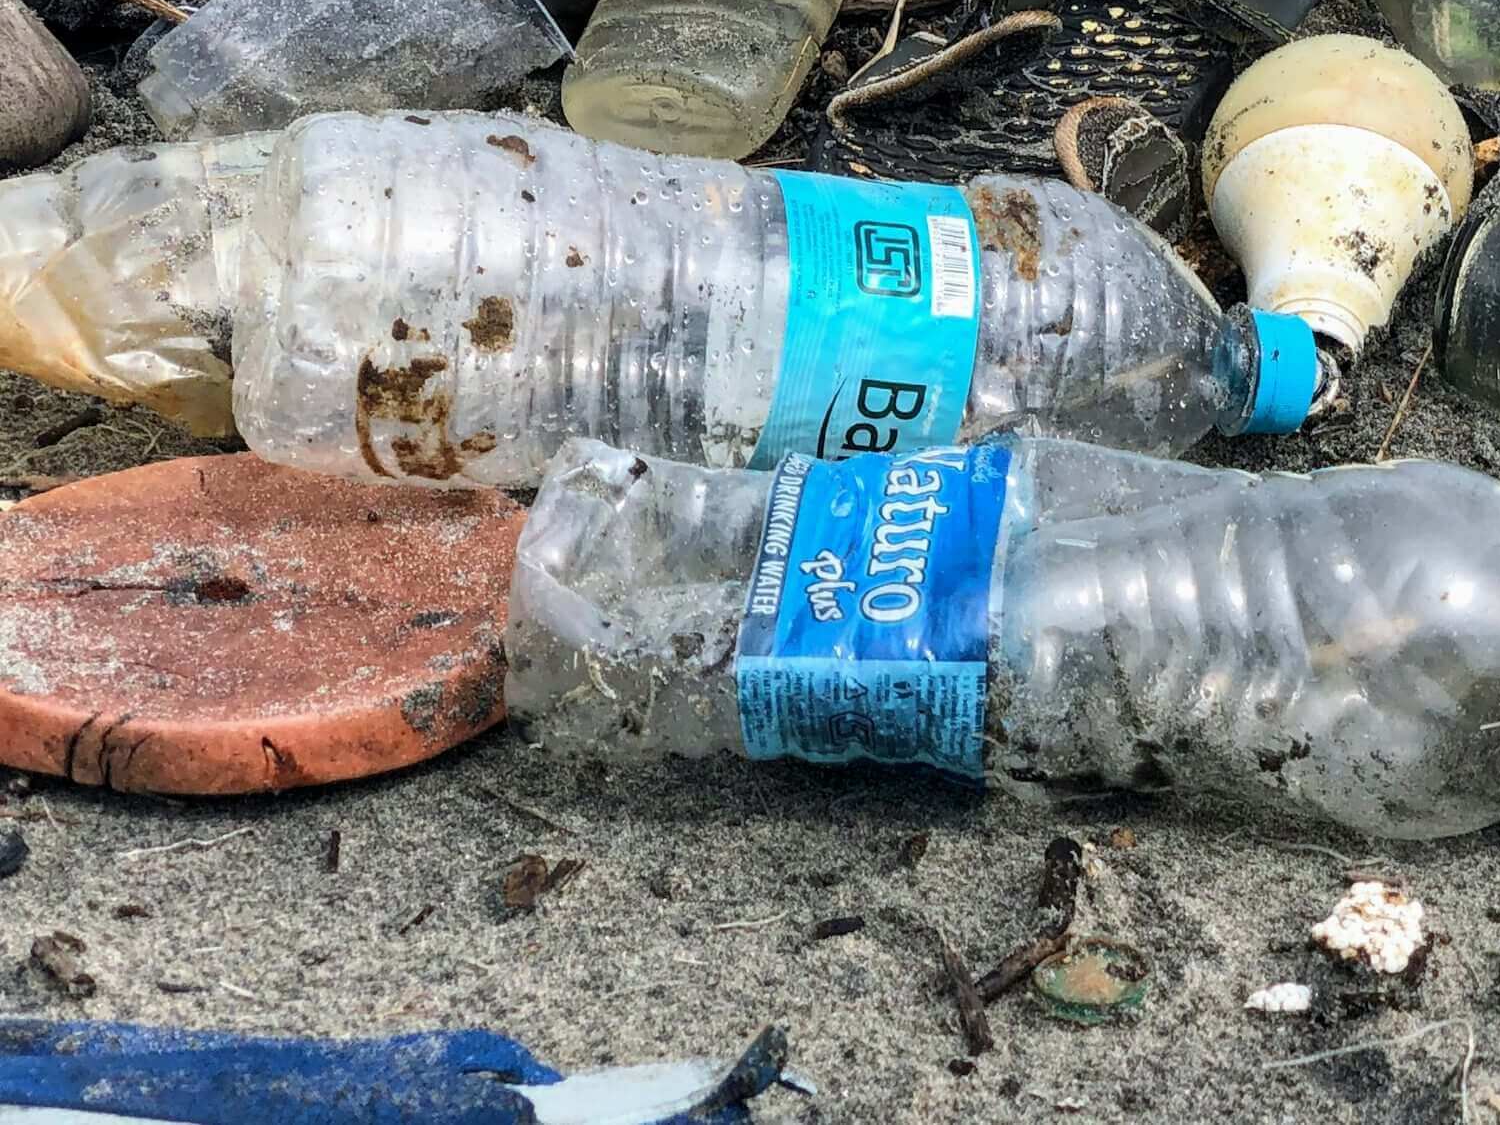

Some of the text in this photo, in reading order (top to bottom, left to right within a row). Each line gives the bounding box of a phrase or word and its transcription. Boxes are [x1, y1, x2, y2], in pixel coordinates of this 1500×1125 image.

[836, 378, 928, 461] Ba
[763, 476, 804, 557] DRINKING
[751, 557, 790, 615] WATER
[800, 549, 856, 623] plus
